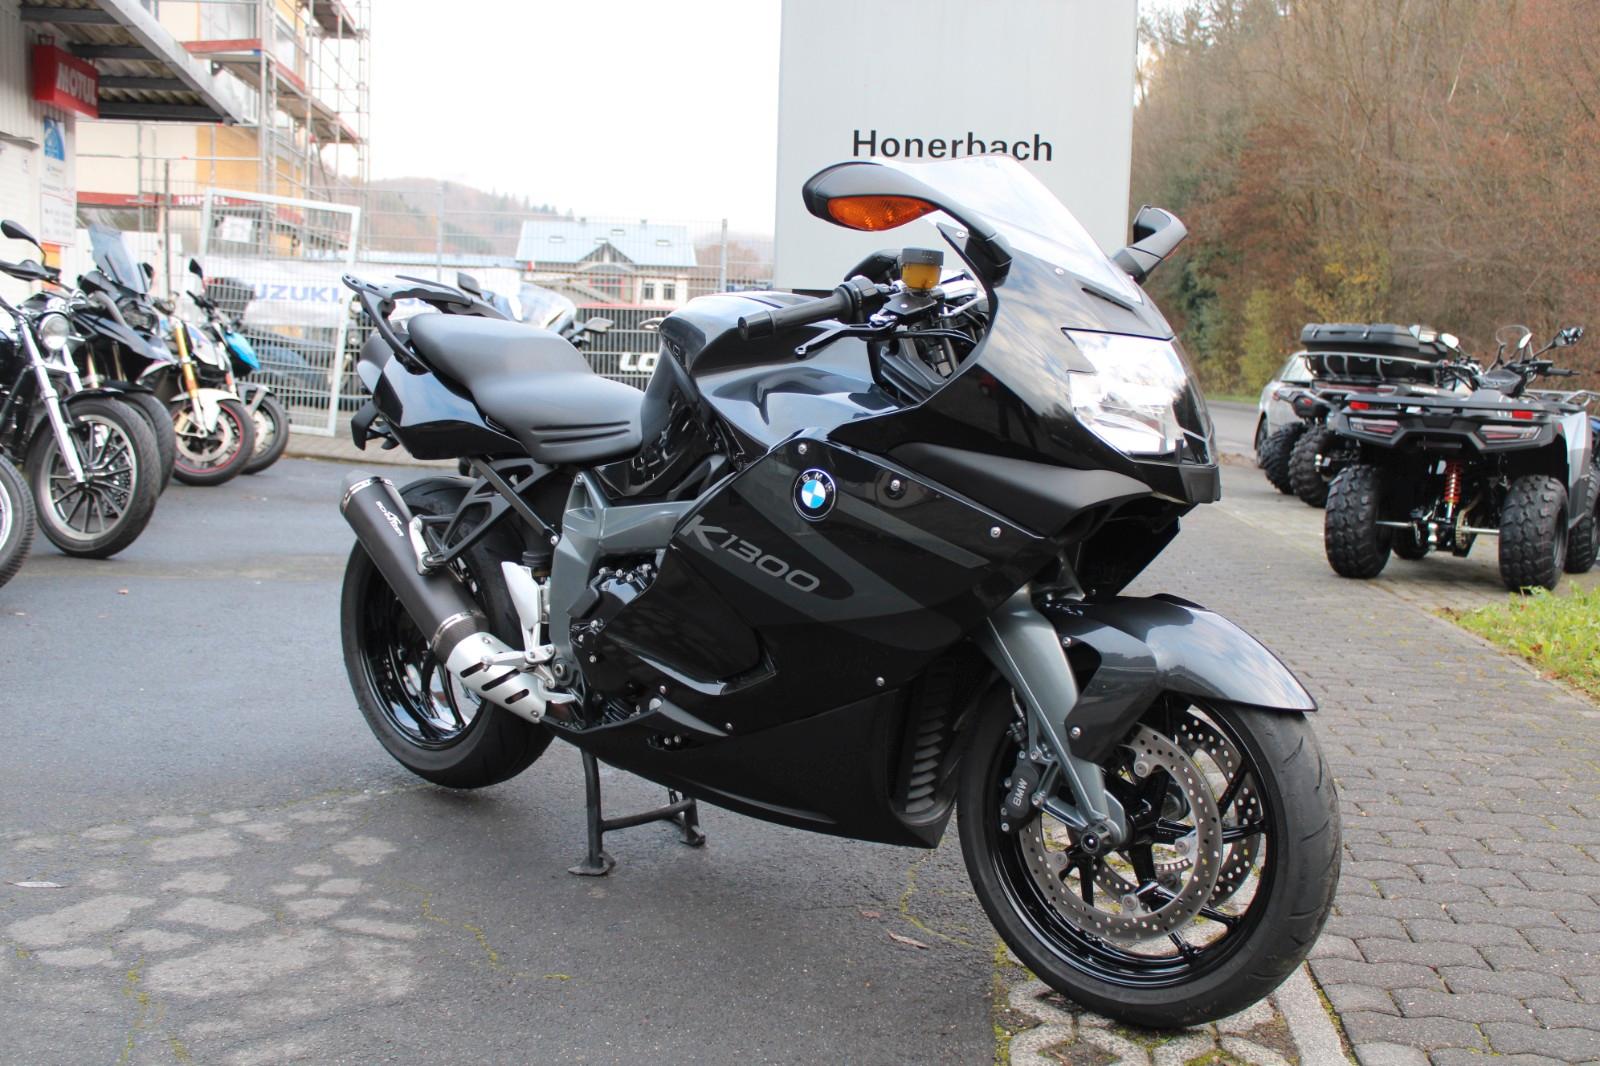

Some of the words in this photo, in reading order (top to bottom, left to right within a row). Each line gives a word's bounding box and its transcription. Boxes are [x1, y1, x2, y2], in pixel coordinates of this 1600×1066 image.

[56, 62, 97, 106] MOTUL
[853, 129, 1052, 162] Honerbach
[251, 283, 340, 303] UZUKI
[801, 471, 833, 492] BMW
[679, 514, 821, 593] K1300
[1012, 777, 1028, 807] BMW
